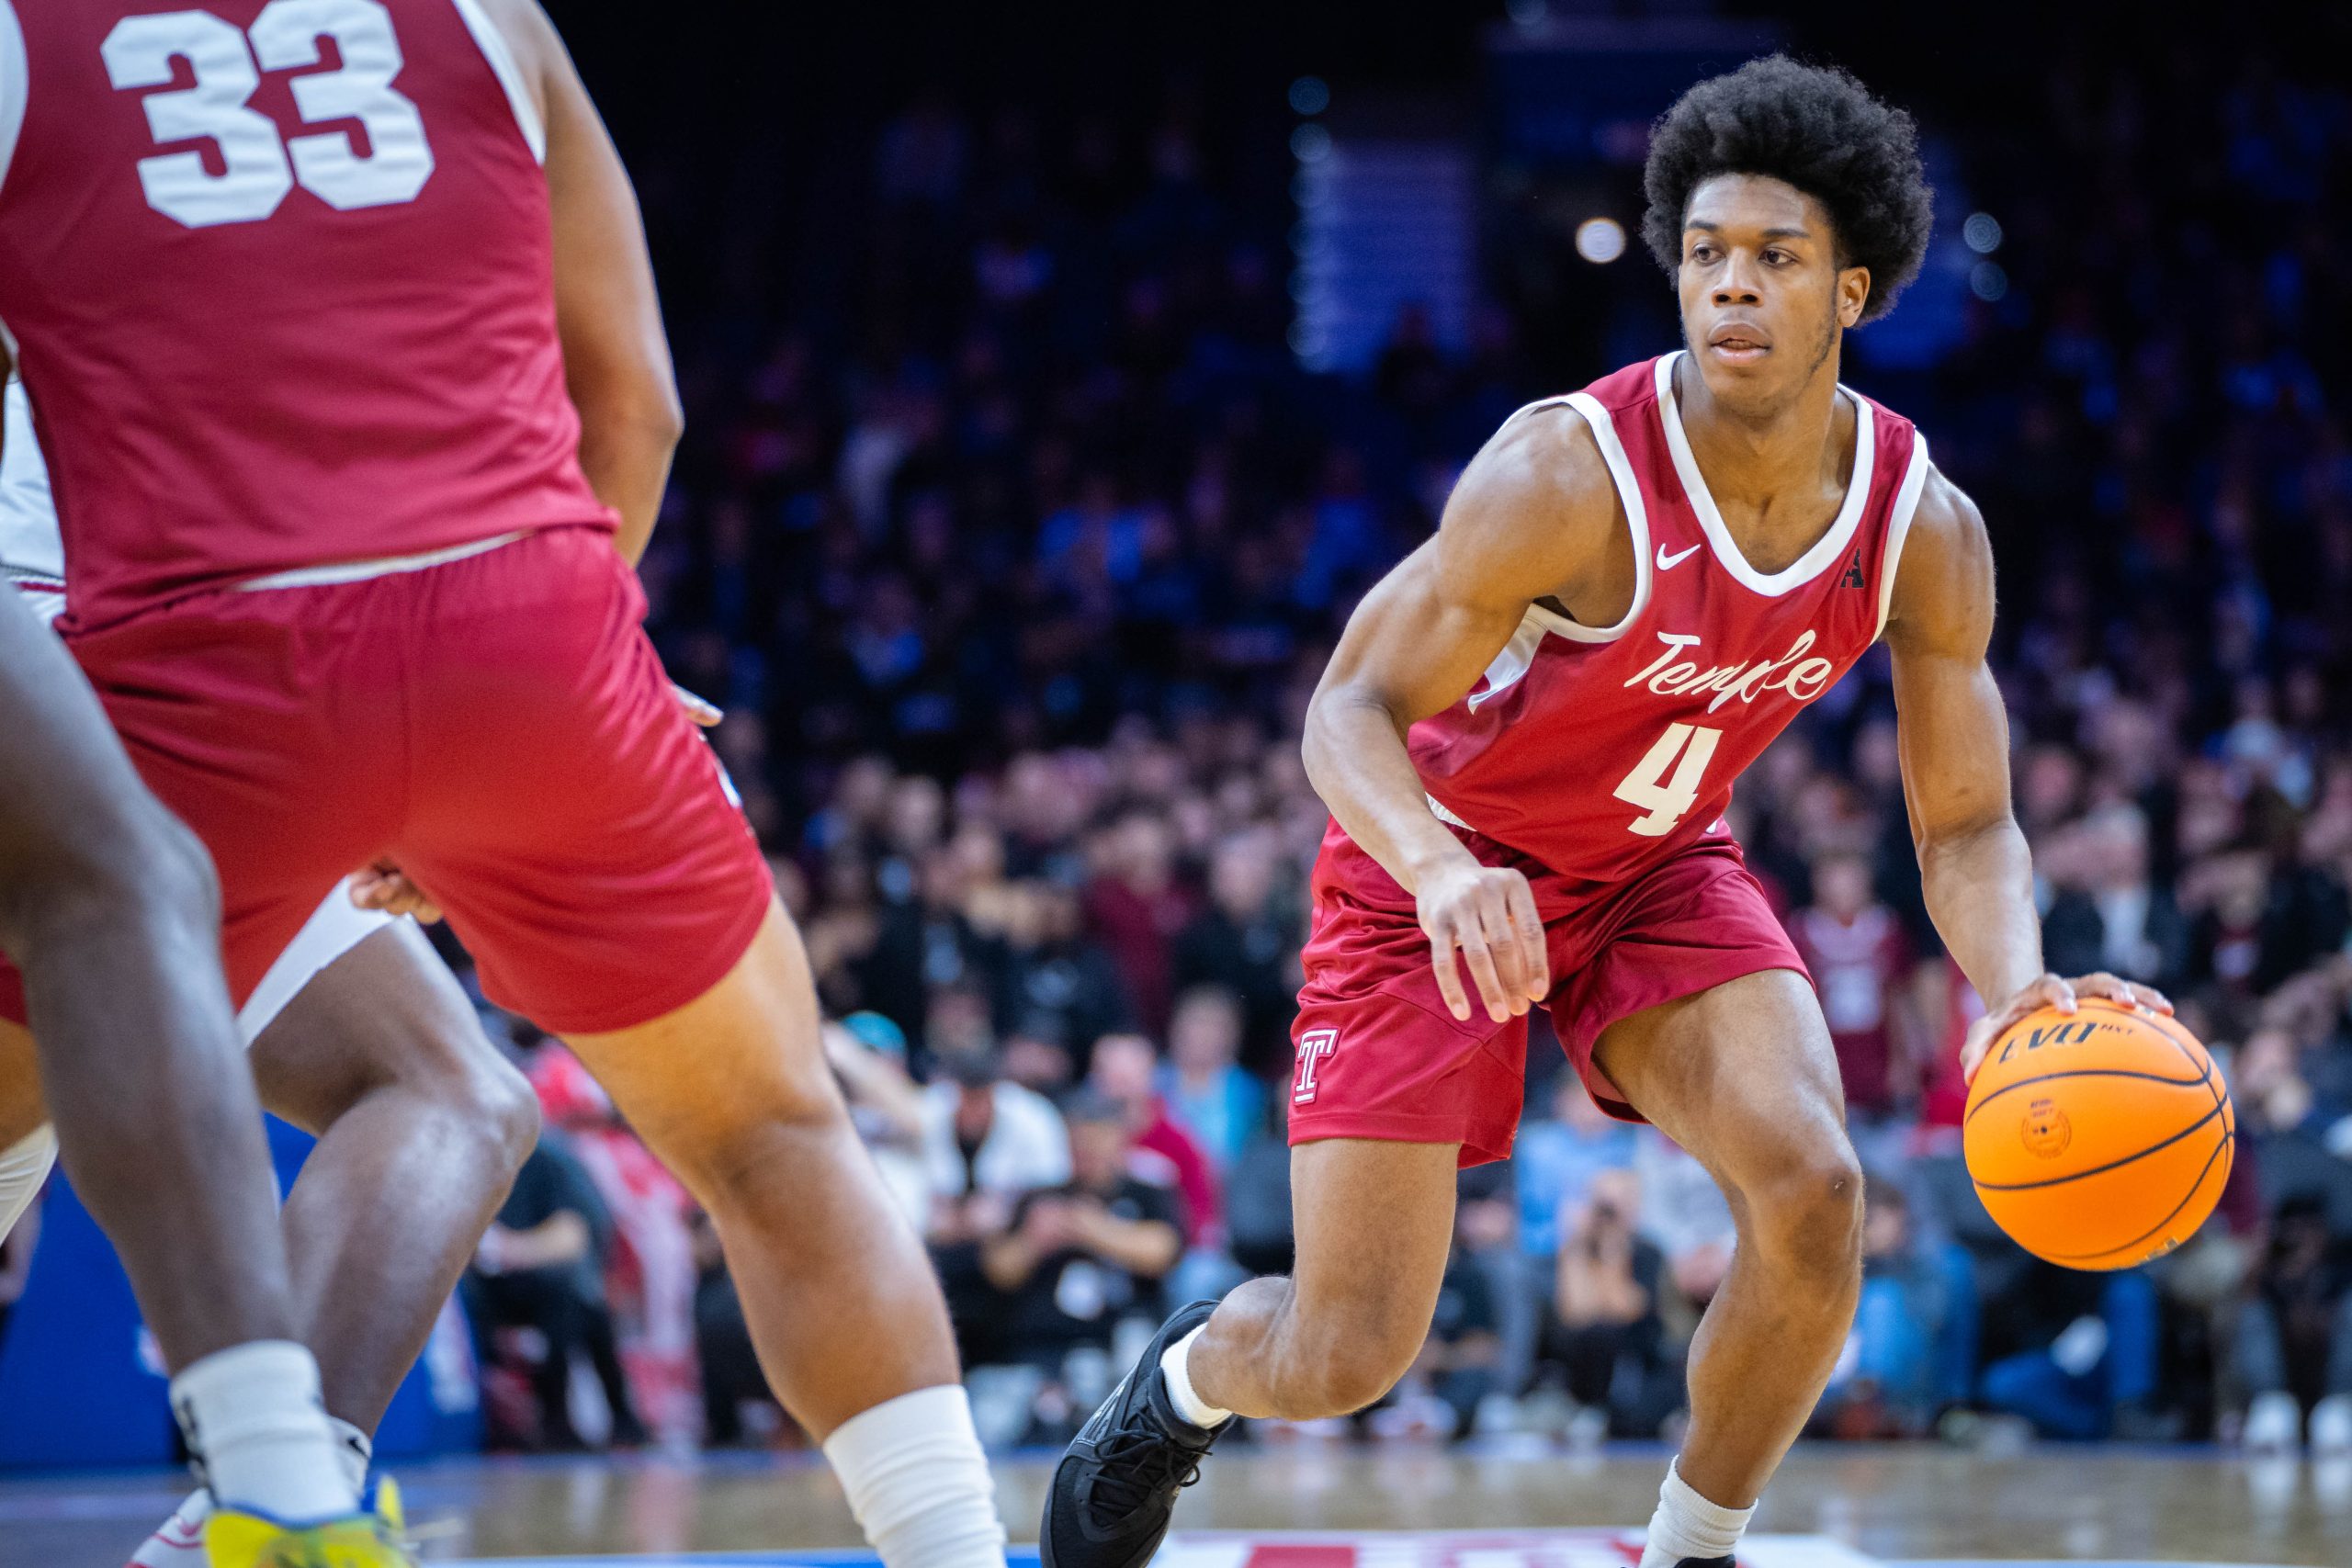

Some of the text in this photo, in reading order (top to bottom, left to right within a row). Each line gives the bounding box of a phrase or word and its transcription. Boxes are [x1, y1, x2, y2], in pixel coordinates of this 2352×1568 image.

[100, 0, 435, 230] 33
[1623, 629, 1833, 714] Temple
[1612, 721, 1724, 837] 4
[1295, 1029, 1338, 1102] T
